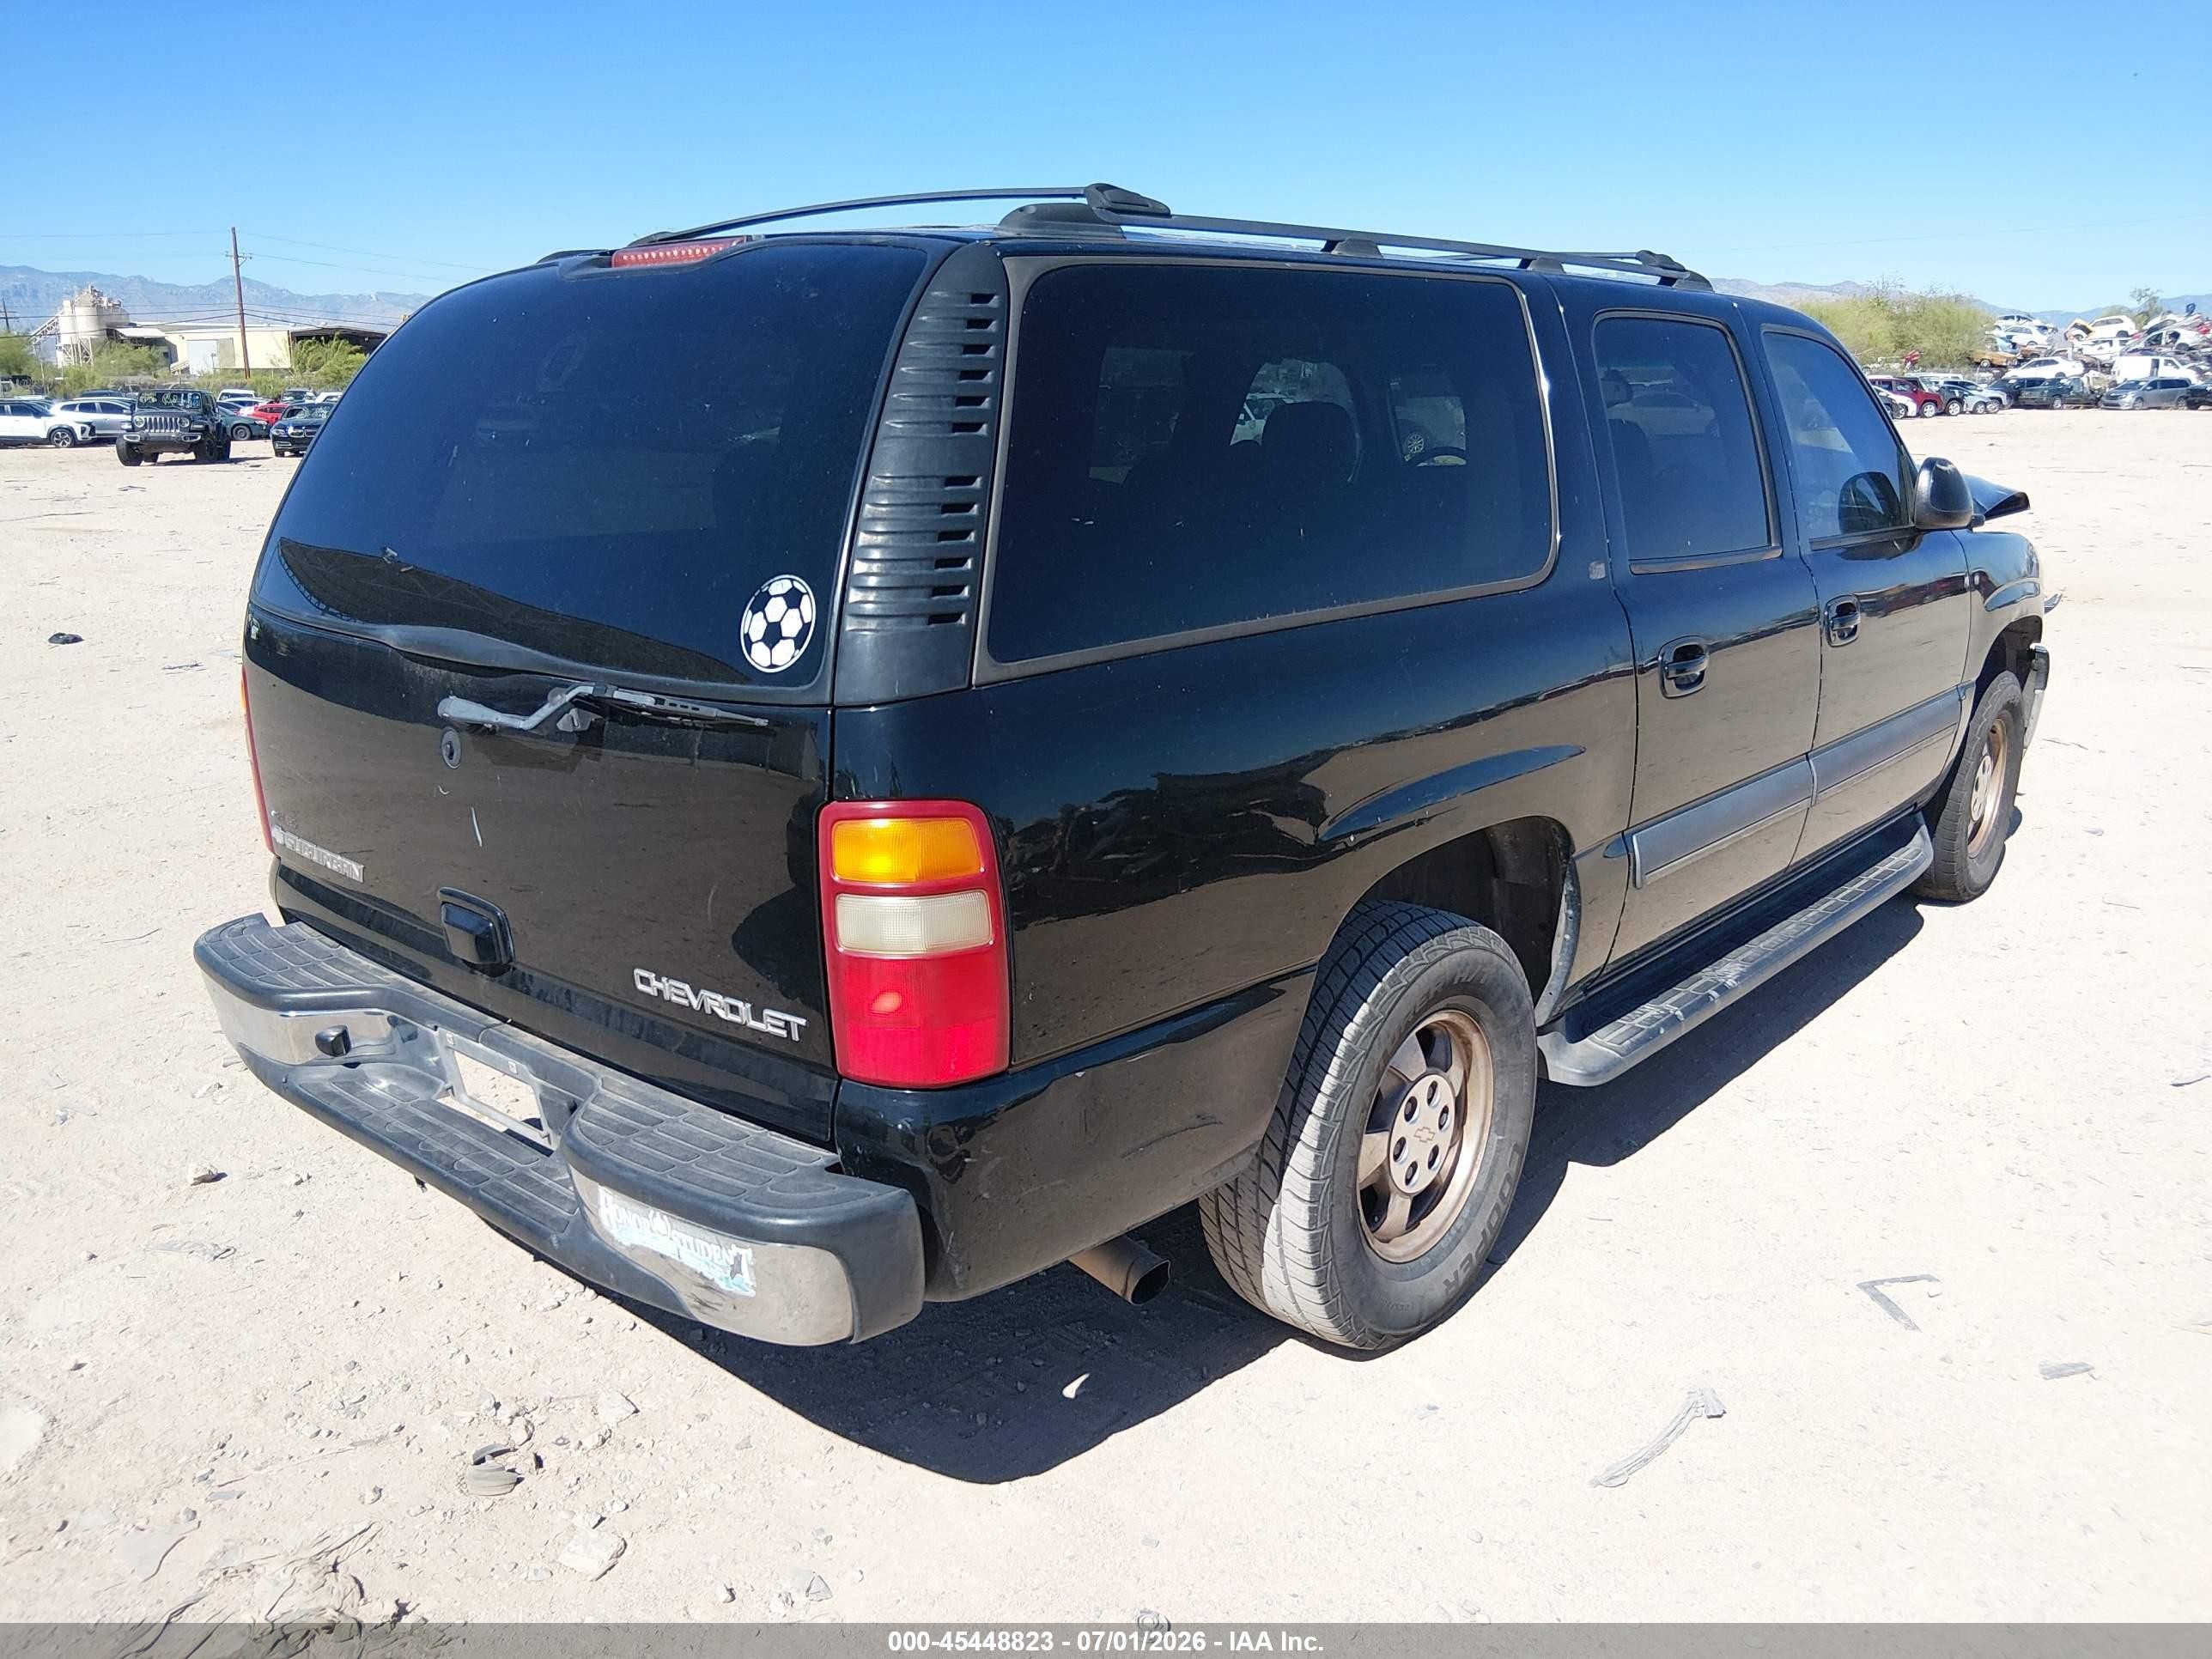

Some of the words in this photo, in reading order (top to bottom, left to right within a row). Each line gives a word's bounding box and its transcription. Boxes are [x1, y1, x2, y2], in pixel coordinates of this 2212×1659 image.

[284, 830, 364, 883] SUBURBAN
[633, 967, 807, 1042] CHEVROLET
[1443, 1140, 1520, 1295] COOPER
